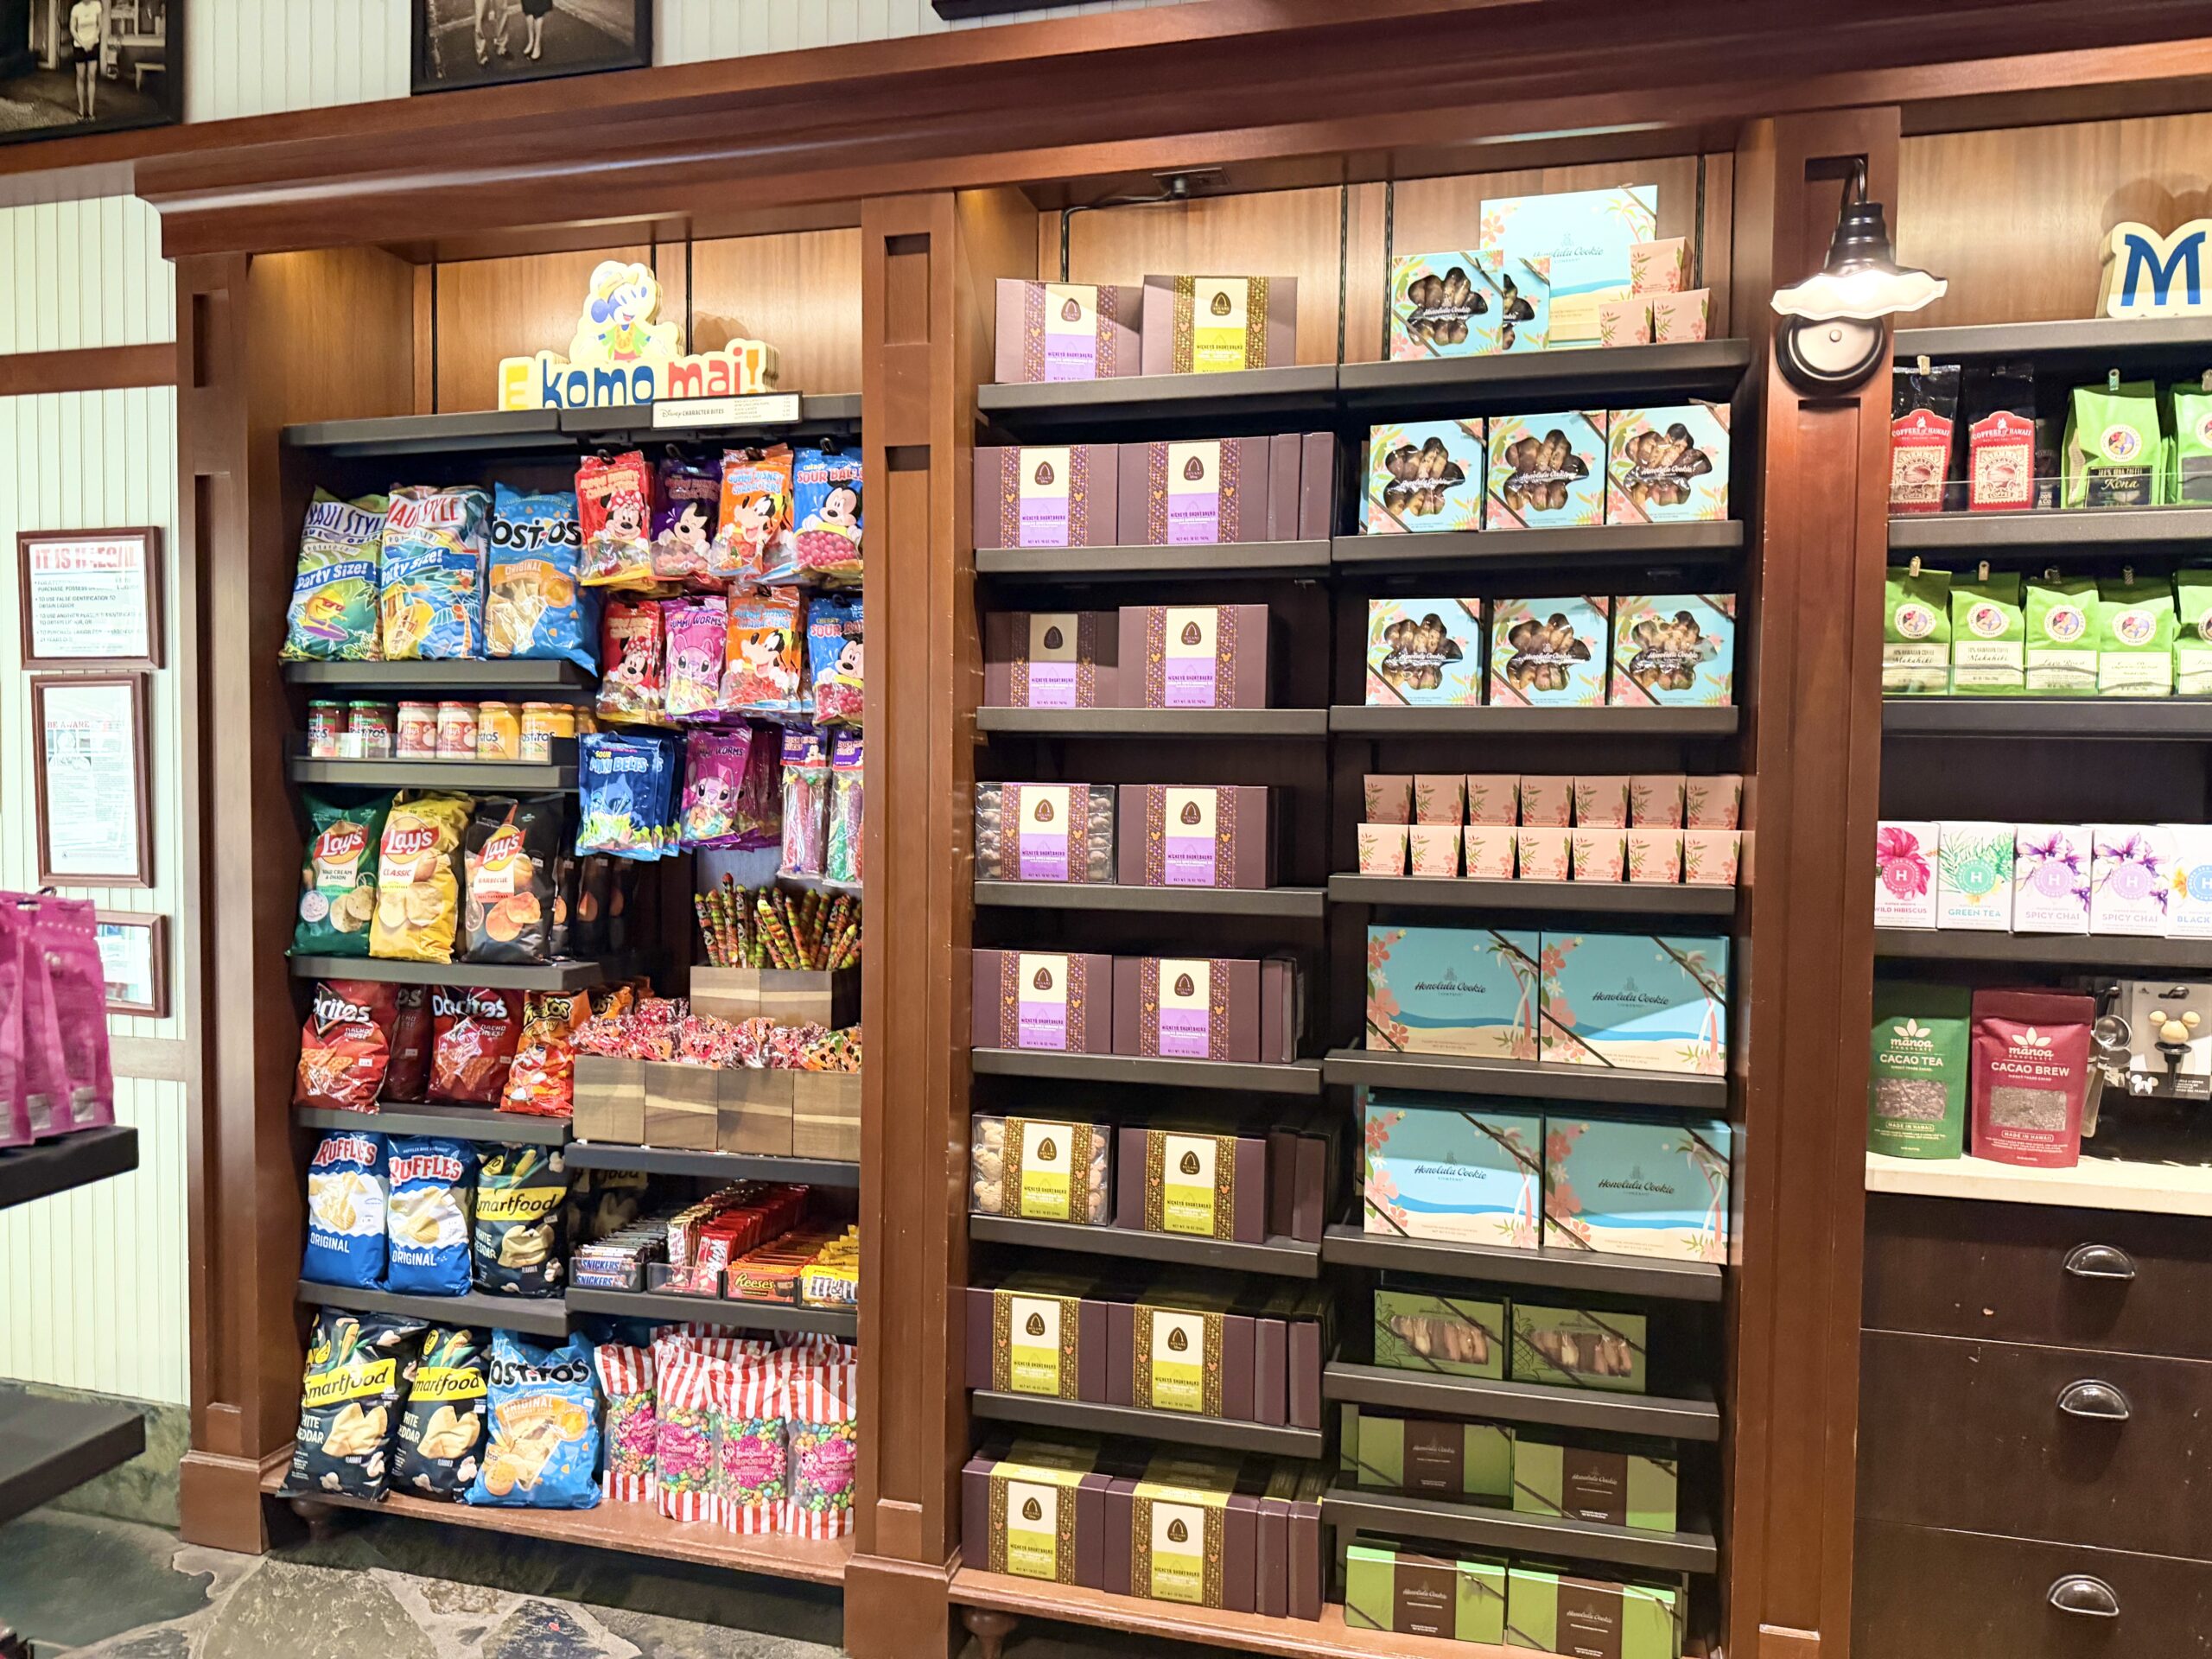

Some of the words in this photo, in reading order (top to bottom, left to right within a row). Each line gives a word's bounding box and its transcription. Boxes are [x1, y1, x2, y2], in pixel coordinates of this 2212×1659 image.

[542, 359, 654, 408] komo
[668, 346, 760, 397] mai!
[797, 470, 827, 483] SOUR
[2101, 477, 2139, 490] Kona
[424, 497, 459, 523] STYLE
[345, 508, 385, 536] STYL
[35, 548, 50, 569] IT
[55, 548, 71, 569] IS
[505, 562, 542, 575] ORIGINAL
[296, 569, 331, 590] Party
[334, 563, 368, 578] Size!
[693, 615, 722, 626] WORMS
[810, 624, 842, 638] SOUR
[715, 746, 744, 756] WORMS
[613, 756, 648, 772] BELTS
[321, 828, 364, 856] Lay's
[385, 827, 433, 855] Lay's
[483, 833, 520, 862] Lay's
[383, 868, 411, 877] CLASSIC
[1895, 869, 1908, 881] H
[1970, 871, 1983, 883] H
[2049, 874, 2060, 886] H
[2126, 876, 2139, 887] H
[1948, 908, 1980, 917] GREEN
[2025, 912, 2056, 920] SPICY
[2056, 912, 2080, 920] CHAI
[2102, 913, 2132, 922] SPICY
[2133, 913, 2158, 922] CHAI
[2177, 915, 2210, 924] BLACK
[1414, 981, 1456, 991] Honolulu
[1457, 982, 1486, 994] Cookie
[1592, 991, 1637, 1002] Honolulu
[1638, 994, 1669, 1006] Cookie
[313, 998, 372, 1022] oritos
[432, 995, 508, 1019] Doritos
[1879, 1053, 1919, 1065] CACAO
[1922, 1056, 1943, 1066] TEA
[1991, 1061, 2032, 1073] CACAO
[2035, 1065, 2069, 1077] BREW
[312, 1138, 378, 1166] RUFFLES
[389, 1154, 464, 1185] RUFFLES
[1414, 1165, 1456, 1175] Honolulu
[1458, 1166, 1487, 1180] Cookie
[1598, 1179, 1643, 1190] Honolulu
[1643, 1181, 1675, 1194] Cookie
[310, 1232, 350, 1254] ORIGINAL
[391, 1251, 437, 1268] ORIGINAL
[582, 1259, 620, 1271] SNICKERS
[577, 1274, 613, 1287] SNICKERS
[491, 1357, 590, 1385] OSTITOS
[414, 1373, 480, 1395] martfood
[302, 1413, 321, 1428] HITE
[404, 1411, 418, 1427] HITE
[398, 1426, 421, 1443] EDDAR
